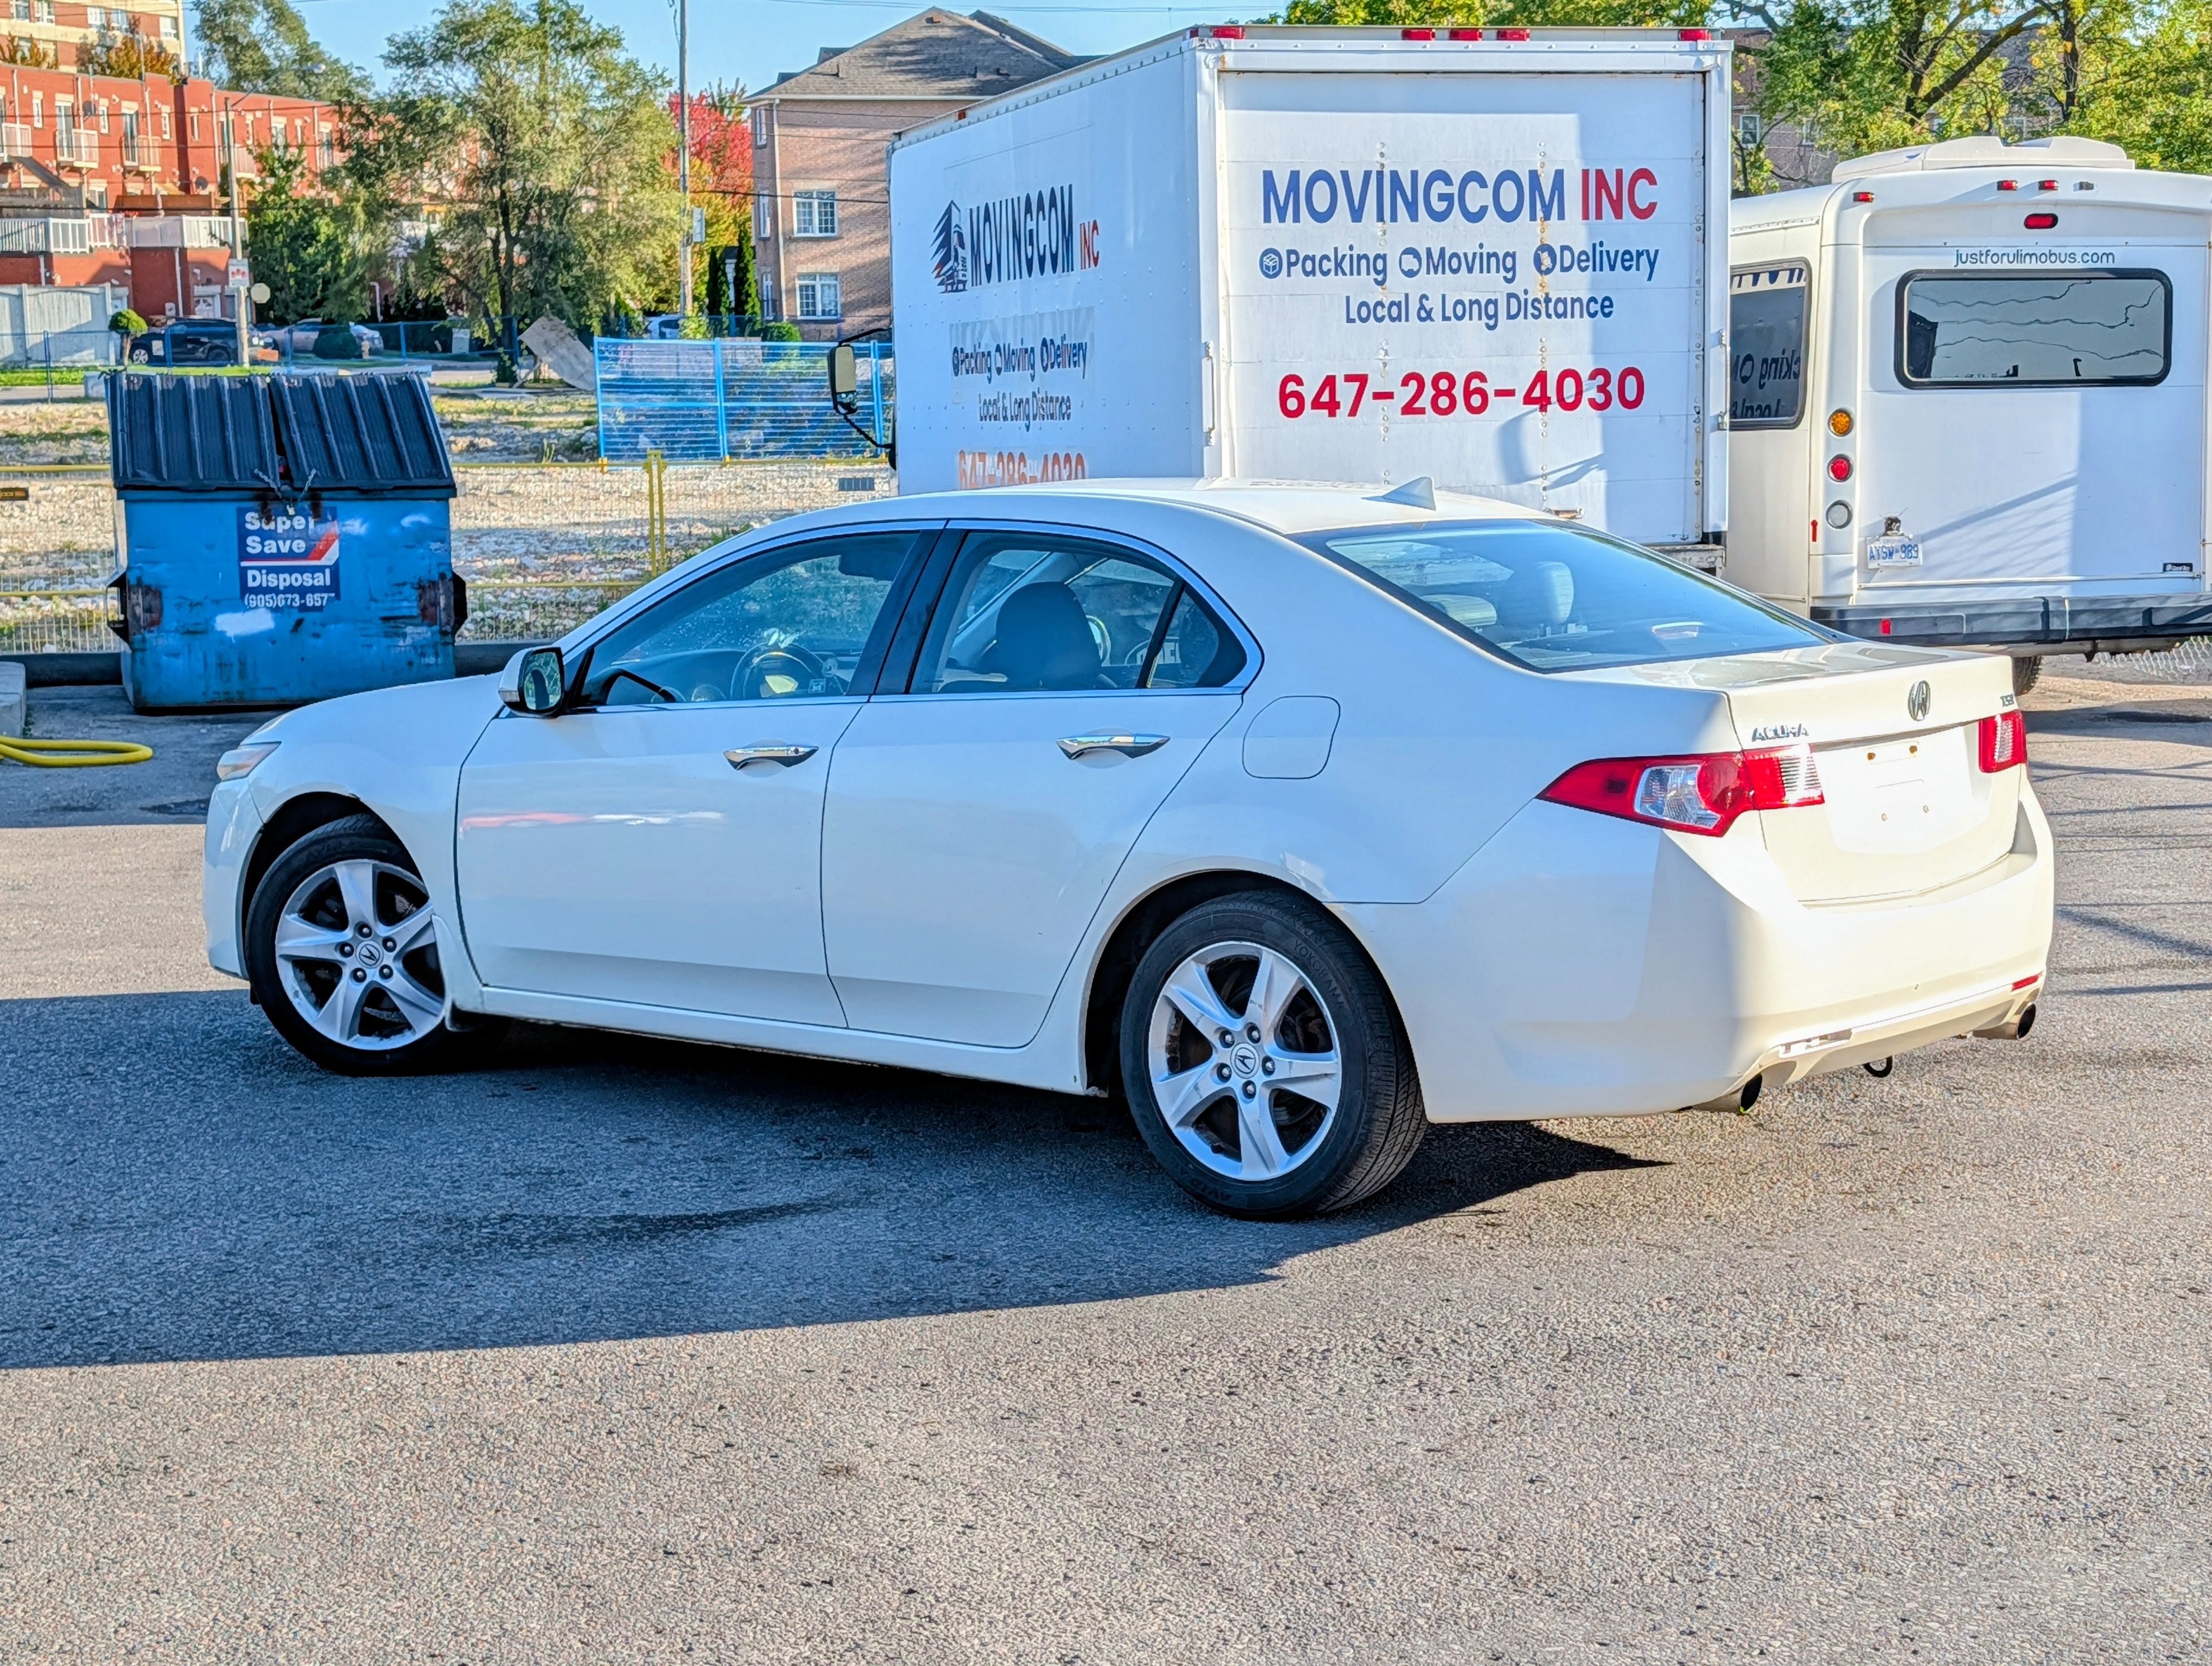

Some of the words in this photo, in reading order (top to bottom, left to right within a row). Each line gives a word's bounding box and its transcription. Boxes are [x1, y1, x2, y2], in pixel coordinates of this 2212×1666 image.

[1262, 169, 1565, 223] MOVINGCOM
[1581, 168, 1658, 221] INC
[969, 183, 1075, 287] MOVINGCOM
[1079, 219, 1100, 270] INC
[1286, 244, 1387, 286] Packing
[1425, 242, 1517, 284] Moving
[1560, 241, 1660, 282] Delivery
[1954, 249, 2115, 267] justforulimobus.com
[1345, 293, 1410, 323] Local
[1417, 293, 1435, 323] &
[1442, 293, 1499, 331] Long
[1506, 289, 1614, 320] Distance
[960, 342, 992, 384] Packing
[1003, 337, 1036, 382] Moving
[1049, 334, 1088, 379] Delivery
[979, 391, 1000, 421] Local
[1009, 392, 1031, 432] Long
[1032, 387, 1071, 421] Distance
[1278, 367, 1645, 418] 647-286-4030
[246, 535, 306, 554] Save
[244, 593, 336, 608] (905)673-657
[247, 568, 331, 590] Disposal
